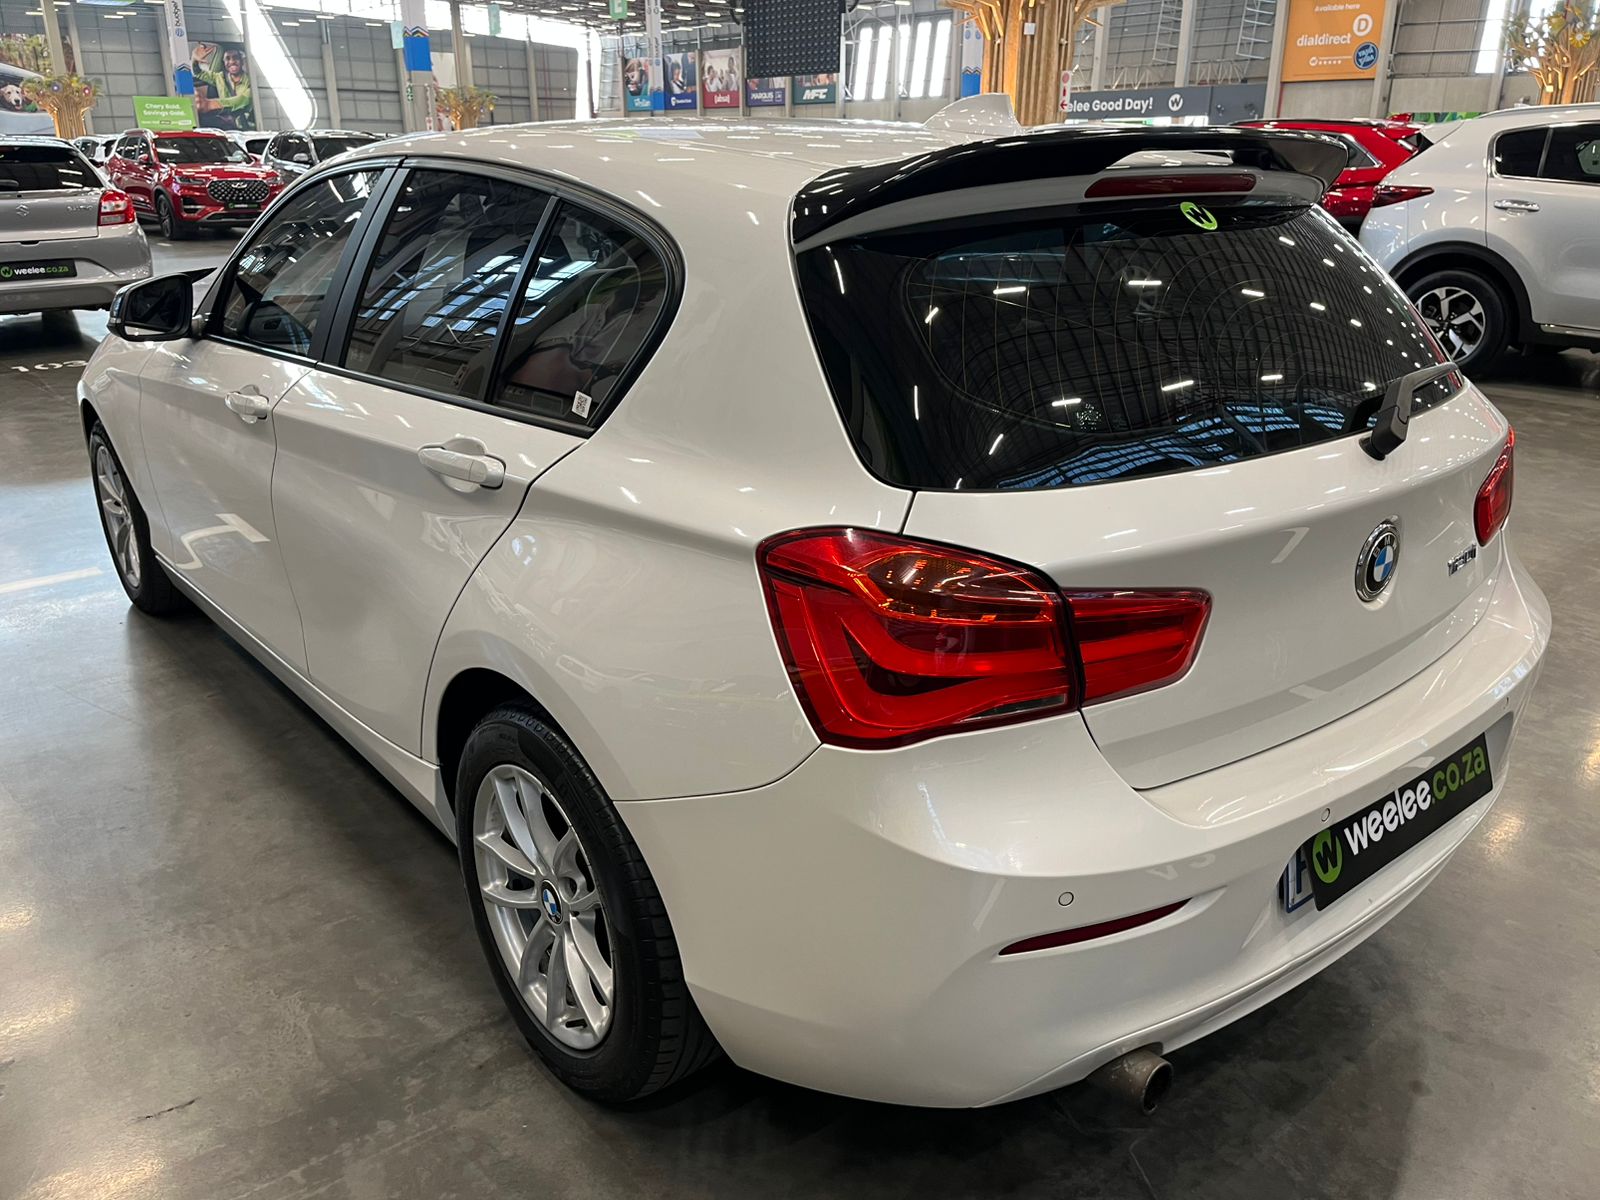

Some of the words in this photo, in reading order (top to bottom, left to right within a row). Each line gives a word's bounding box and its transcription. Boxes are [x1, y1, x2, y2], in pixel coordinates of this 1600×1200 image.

[1296, 33, 1352, 47] dialdirect
[803, 88, 828, 100] MFC
[1067, 98, 1091, 112] elee
[1091, 98, 1123, 112] Good
[1125, 97, 1153, 113] Day!
[14, 265, 69, 276] weelee.co.za
[1344, 746, 1486, 856] weelee.co.za
